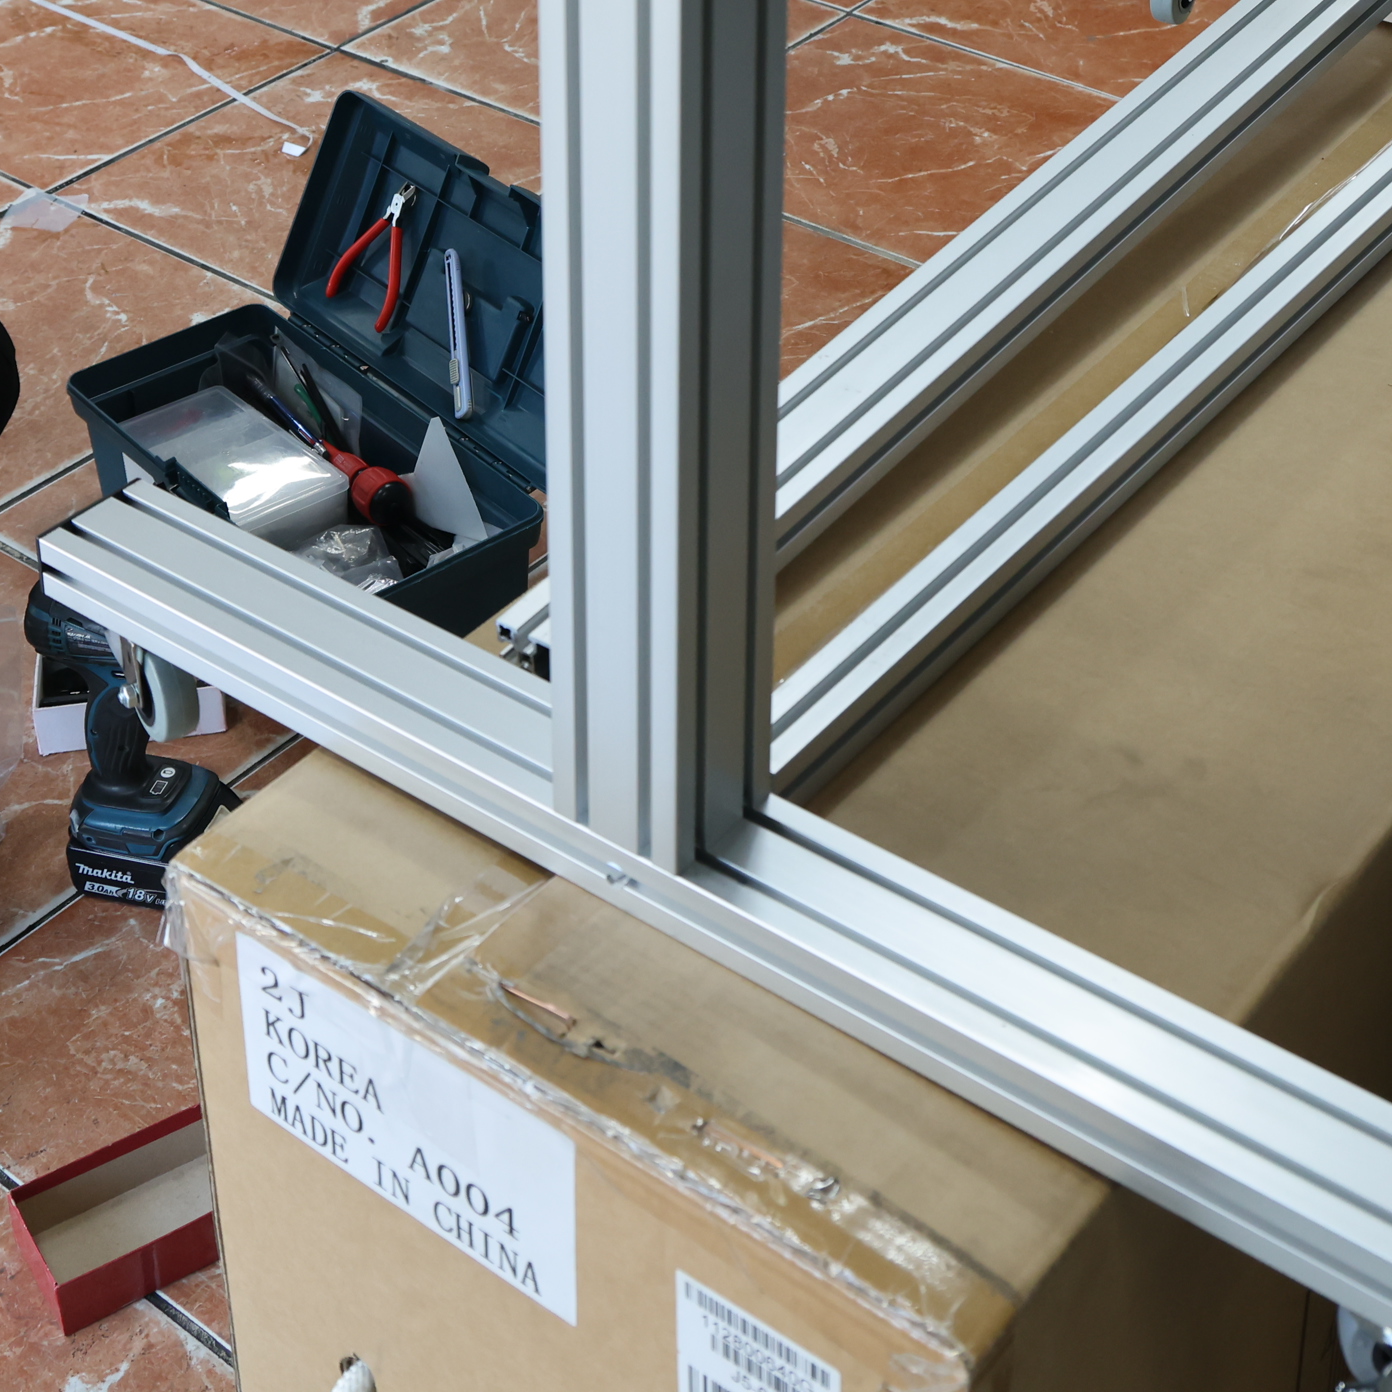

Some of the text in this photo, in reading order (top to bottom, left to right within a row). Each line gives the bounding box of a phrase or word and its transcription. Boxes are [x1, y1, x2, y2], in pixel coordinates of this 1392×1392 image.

[261, 966, 309, 1020] 2J
[263, 1008, 385, 1114] KOREA
[267, 1052, 520, 1241] C/NO. A004
[269, 1086, 542, 1297] MADE IN CHINA
